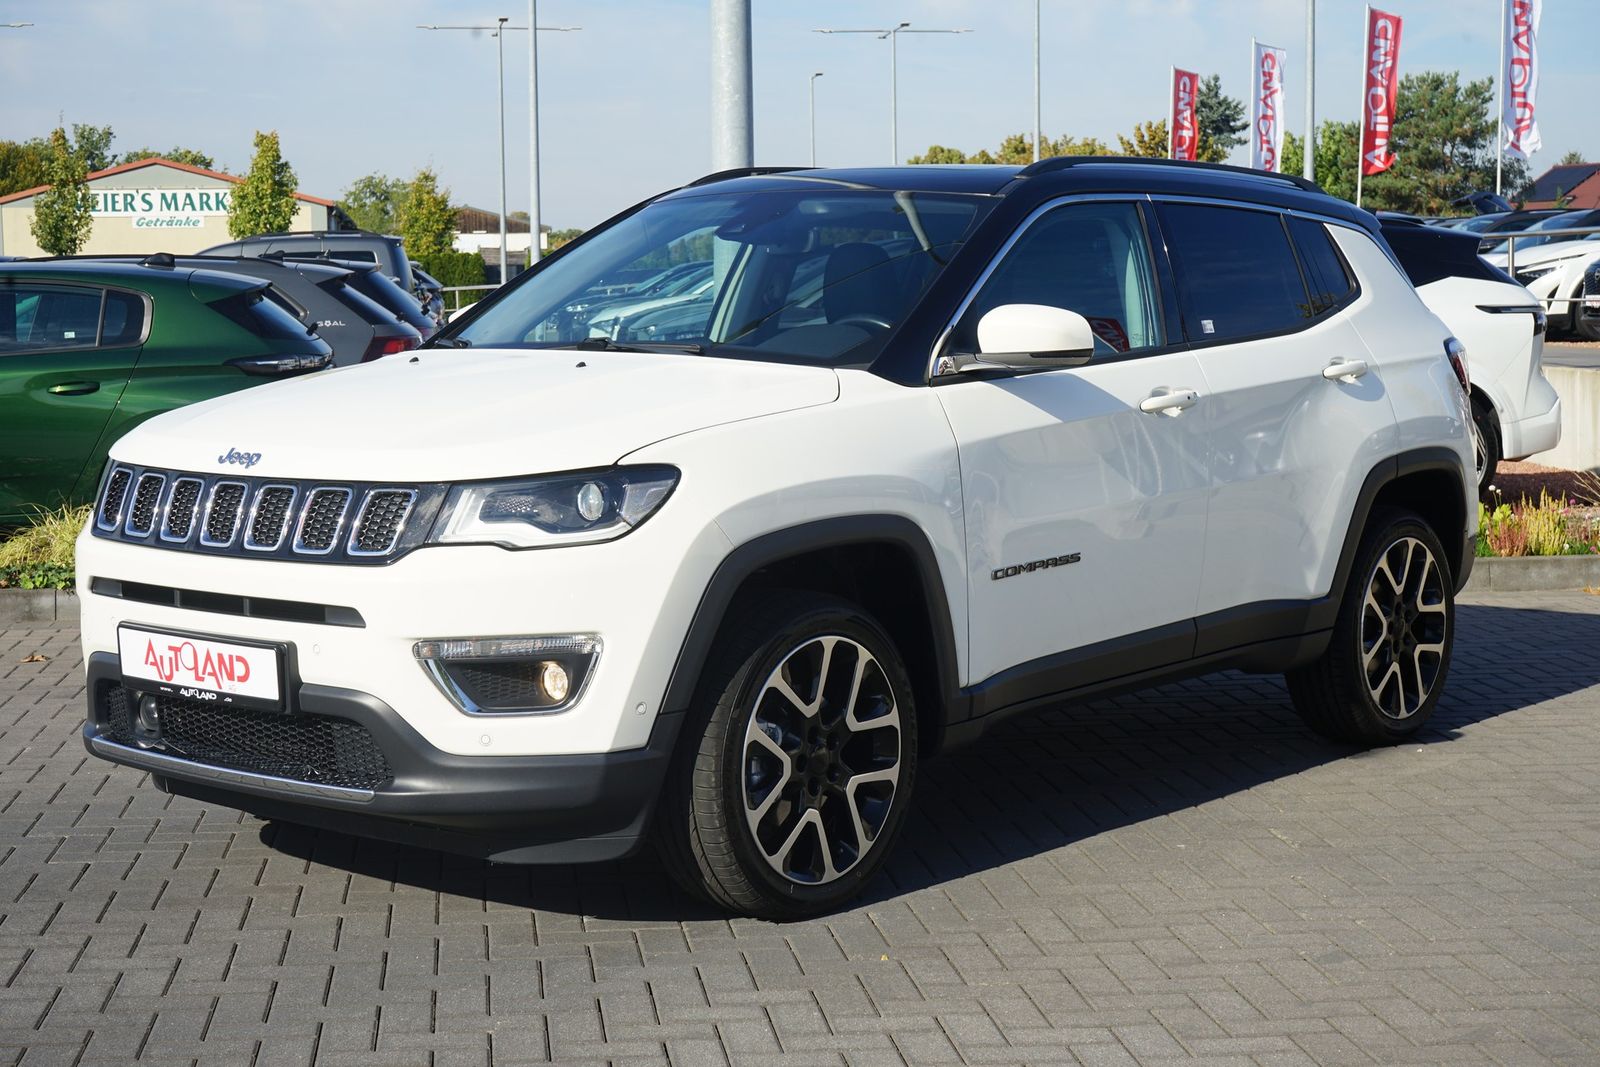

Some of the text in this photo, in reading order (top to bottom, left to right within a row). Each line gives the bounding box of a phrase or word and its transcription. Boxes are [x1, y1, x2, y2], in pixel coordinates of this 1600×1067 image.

[1509, 0, 1534, 152] AUTOLAN
[1175, 76, 1194, 160] TOLAND
[76, 189, 229, 212] EIER'S MARK
[136, 216, 200, 227] Getränke
[218, 447, 262, 469] Jeep
[991, 552, 1081, 581] COMPASS
[145, 638, 250, 689] AUTOLAND
[180, 687, 217, 700] AUTOLAND
